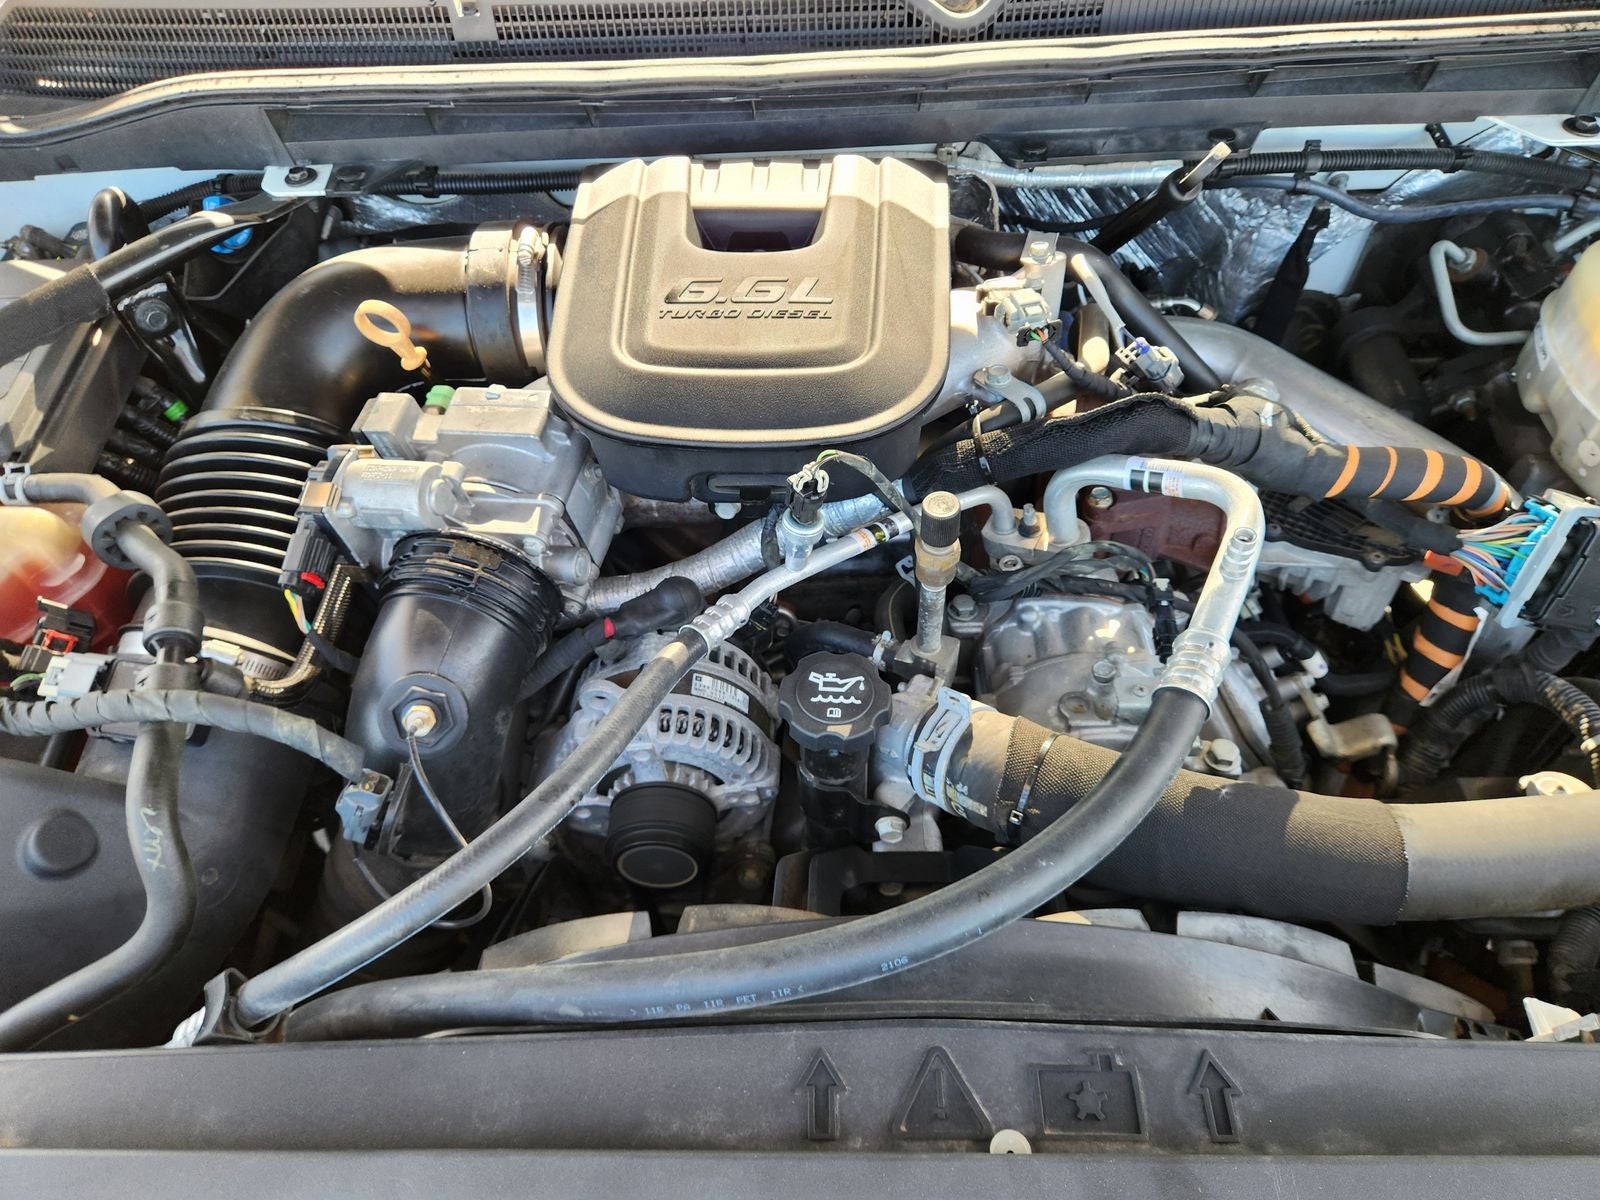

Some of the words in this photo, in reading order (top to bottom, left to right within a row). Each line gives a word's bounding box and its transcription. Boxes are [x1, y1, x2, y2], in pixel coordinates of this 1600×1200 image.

[664, 277, 834, 304] 6.6L
[659, 309, 742, 320] TURBO
[746, 309, 833, 320] DIESEL
